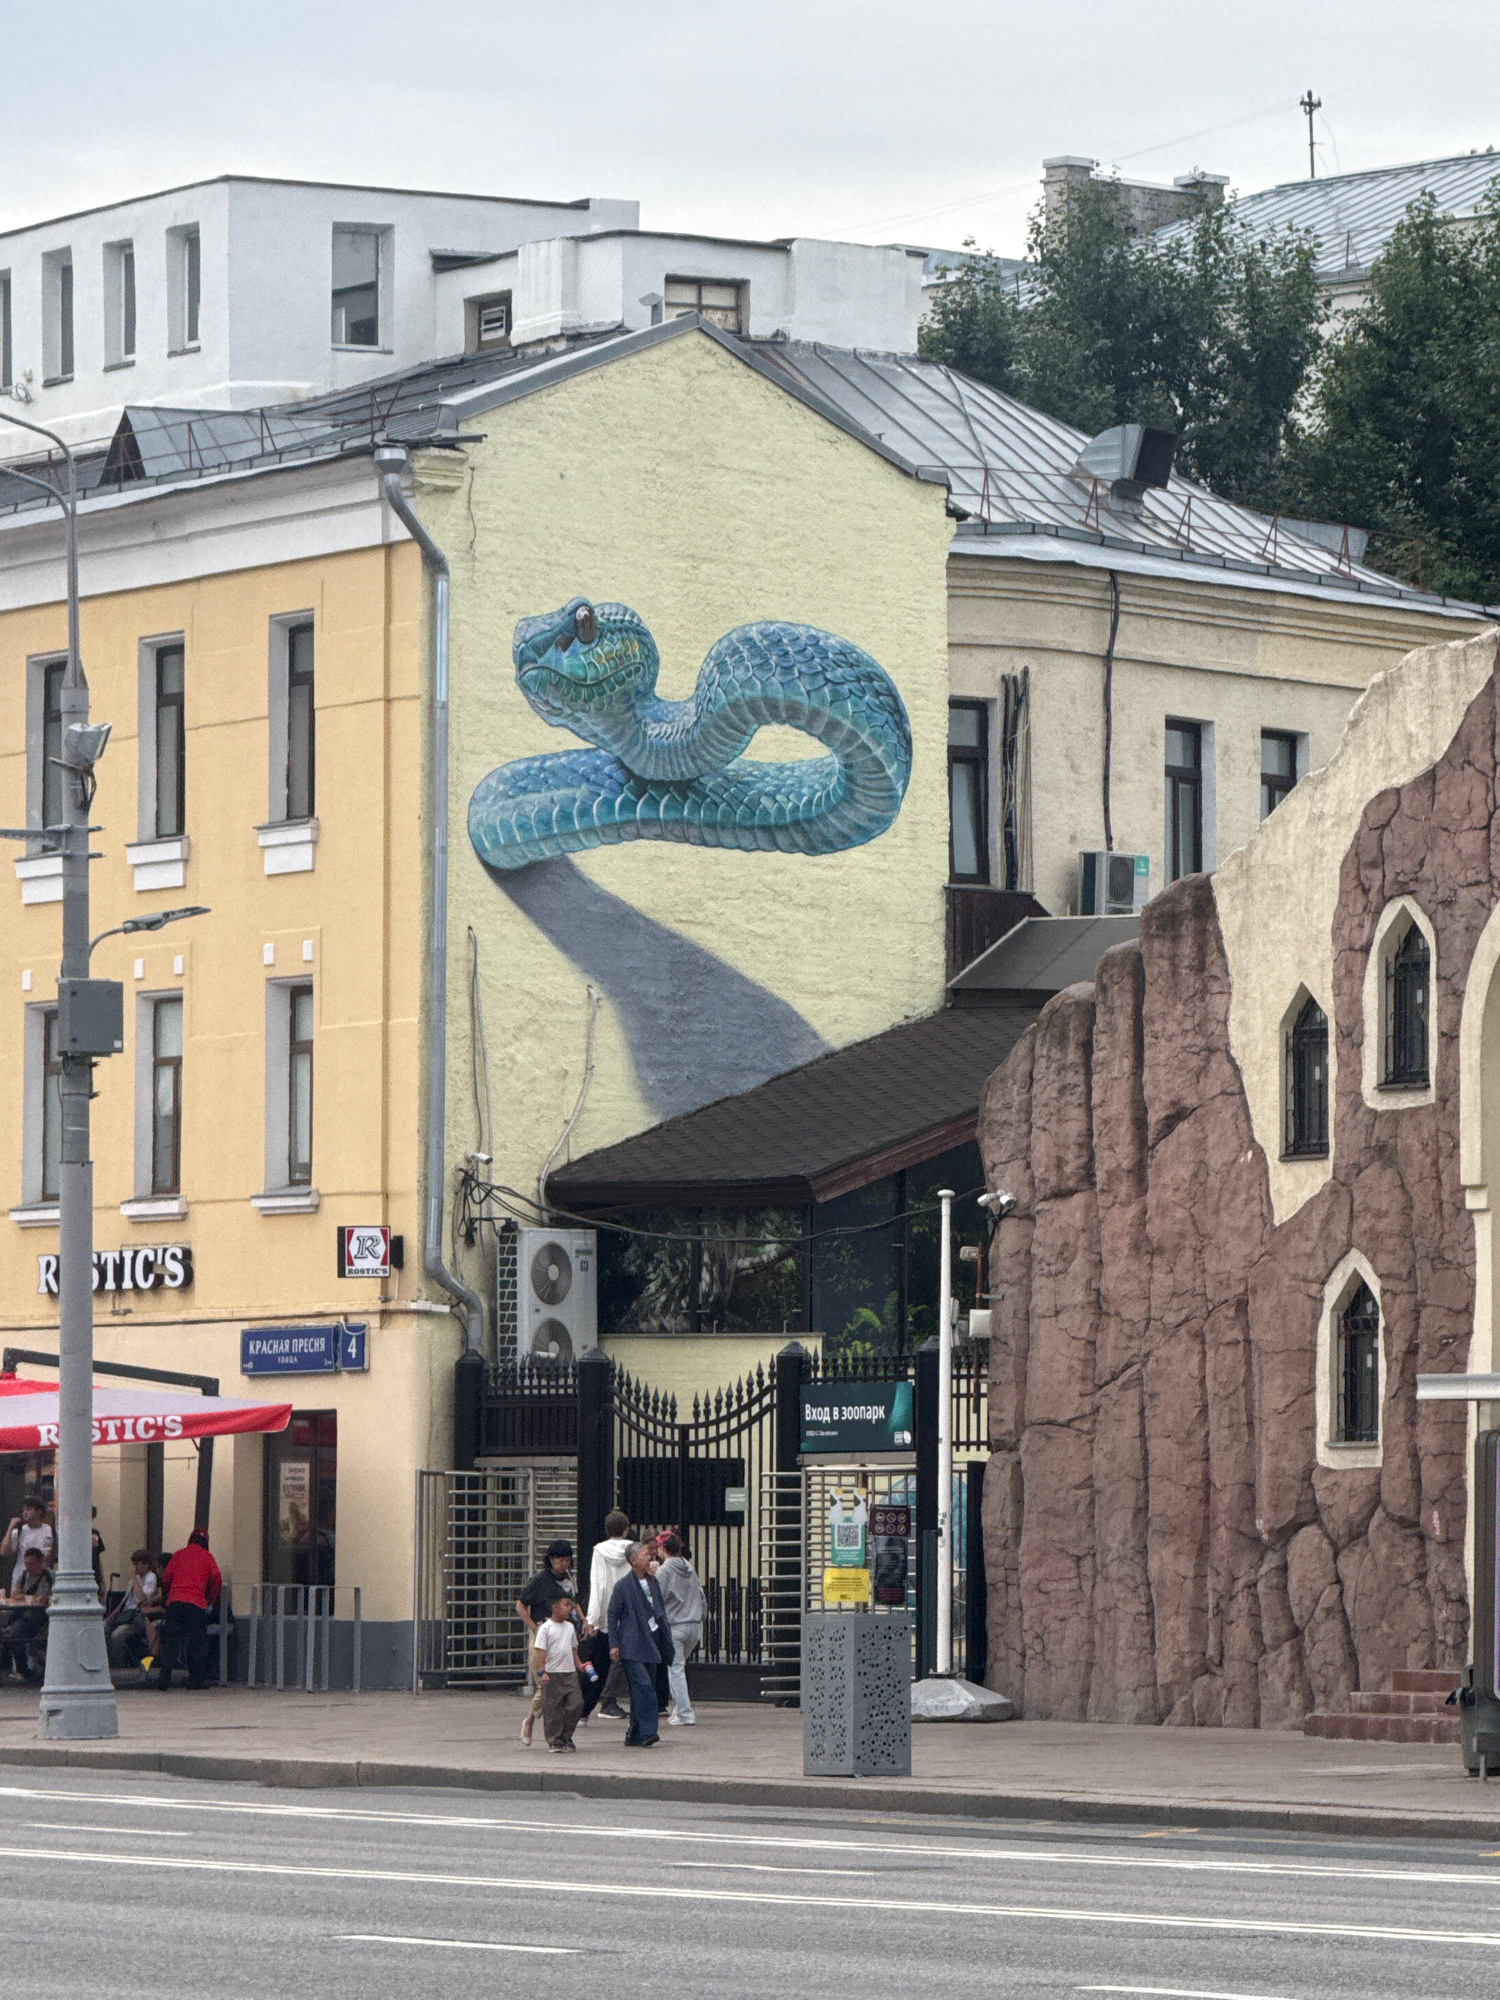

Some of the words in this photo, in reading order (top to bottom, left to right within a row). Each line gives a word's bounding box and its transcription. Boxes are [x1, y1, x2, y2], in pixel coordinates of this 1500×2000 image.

[354, 1235, 381, 1259] R
[37, 1247, 185, 1293] RTIC'S
[249, 1339, 290, 1355] КРАСНАЯ
[292, 1337, 325, 1353] ПРЕСНЯ
[347, 1335, 357, 1359] 4
[805, 1403, 831, 1424] Вход
[833, 1406, 840, 1420] в
[841, 1405, 886, 1424] зоопарк
[37, 1415, 183, 1447] RTIC'S
